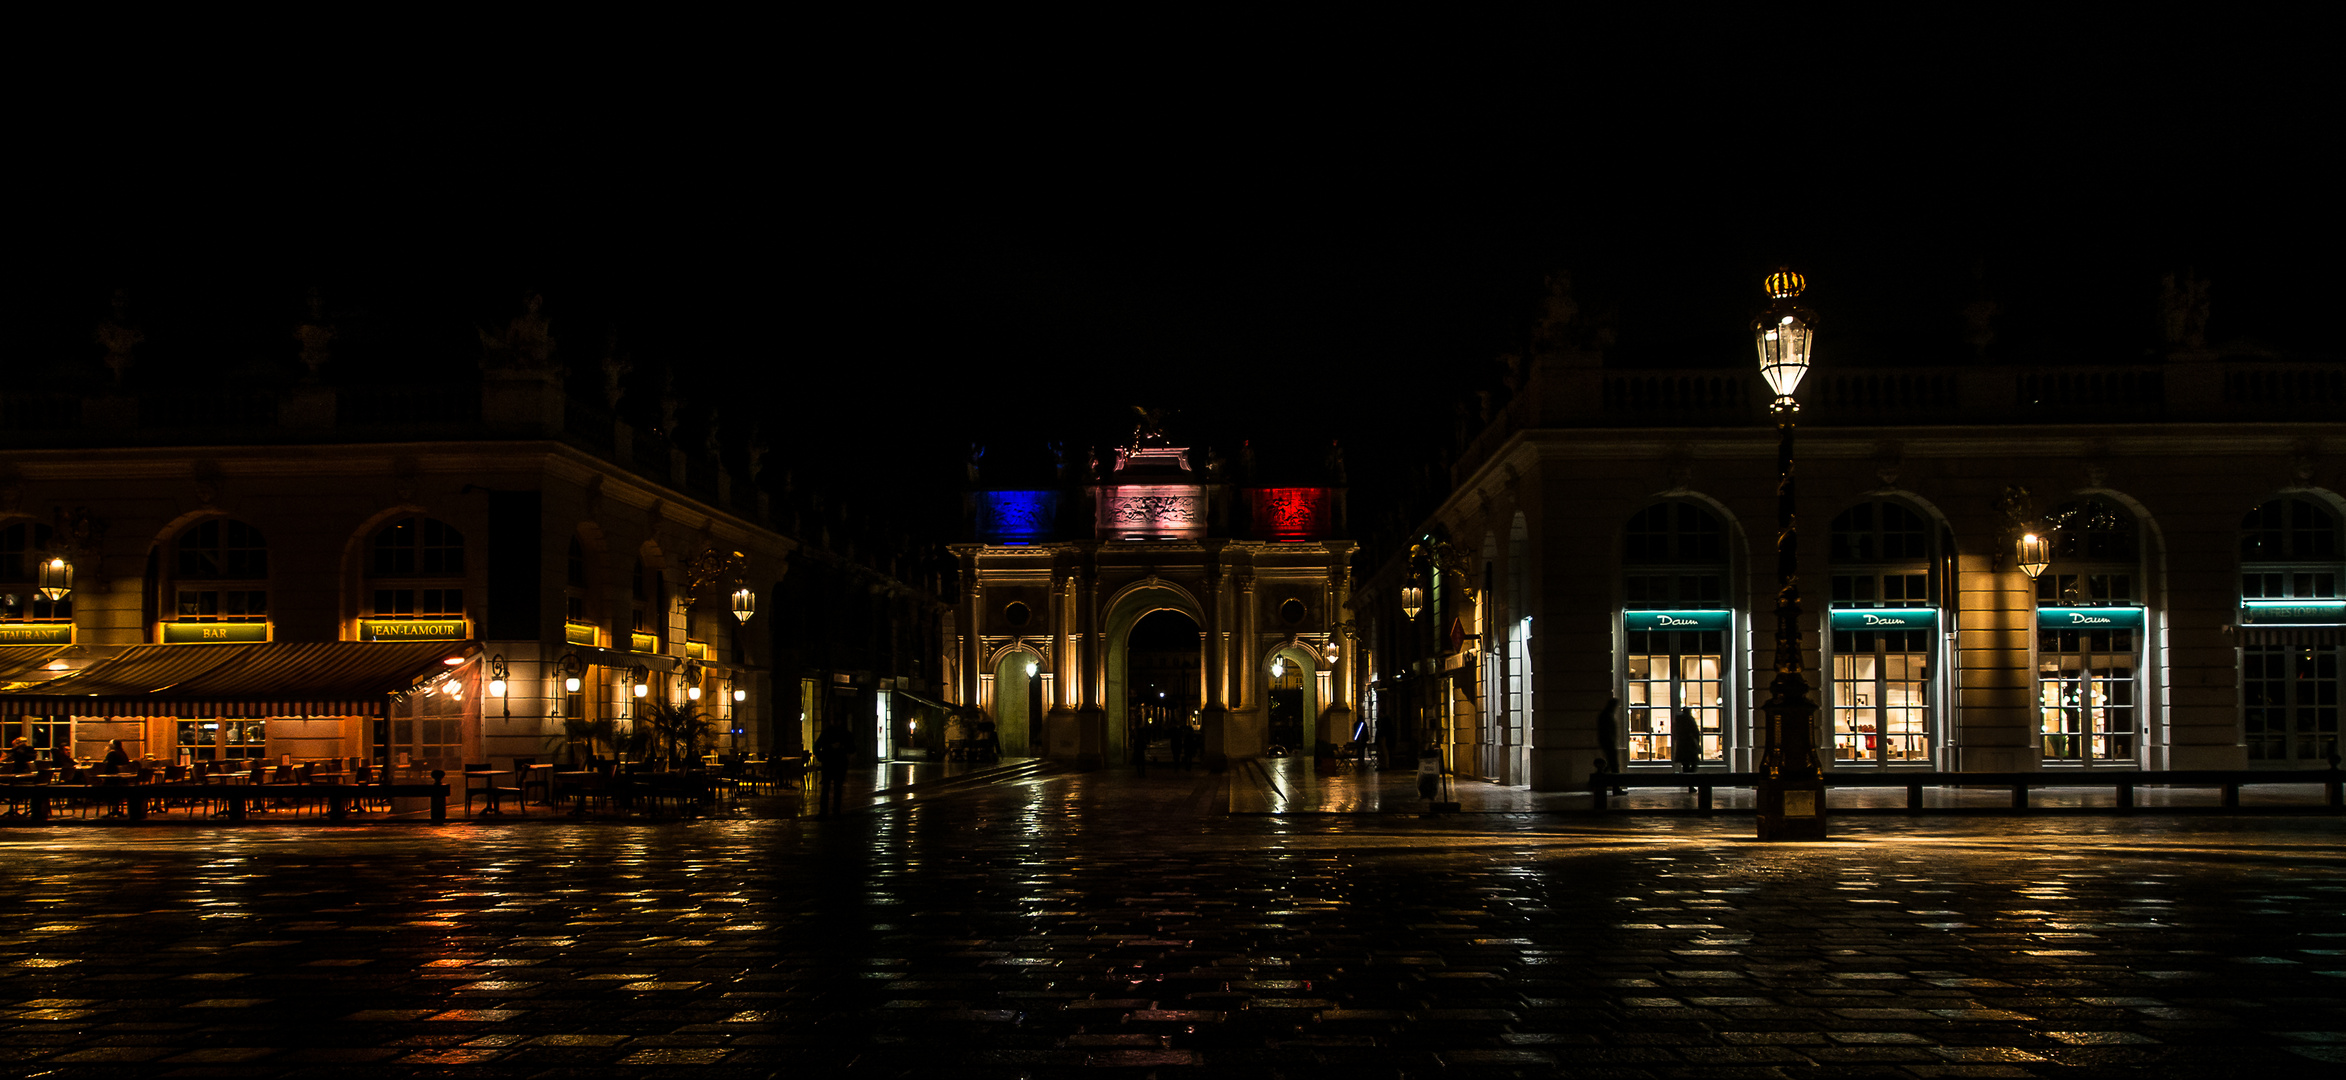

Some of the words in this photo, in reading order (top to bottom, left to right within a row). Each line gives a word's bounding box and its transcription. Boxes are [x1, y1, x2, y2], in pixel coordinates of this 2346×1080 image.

[1656, 614, 1699, 626] Daum
[1862, 613, 1906, 625] Daum
[2068, 612, 2111, 624] Daum
[203, 628, 227, 639] BAR
